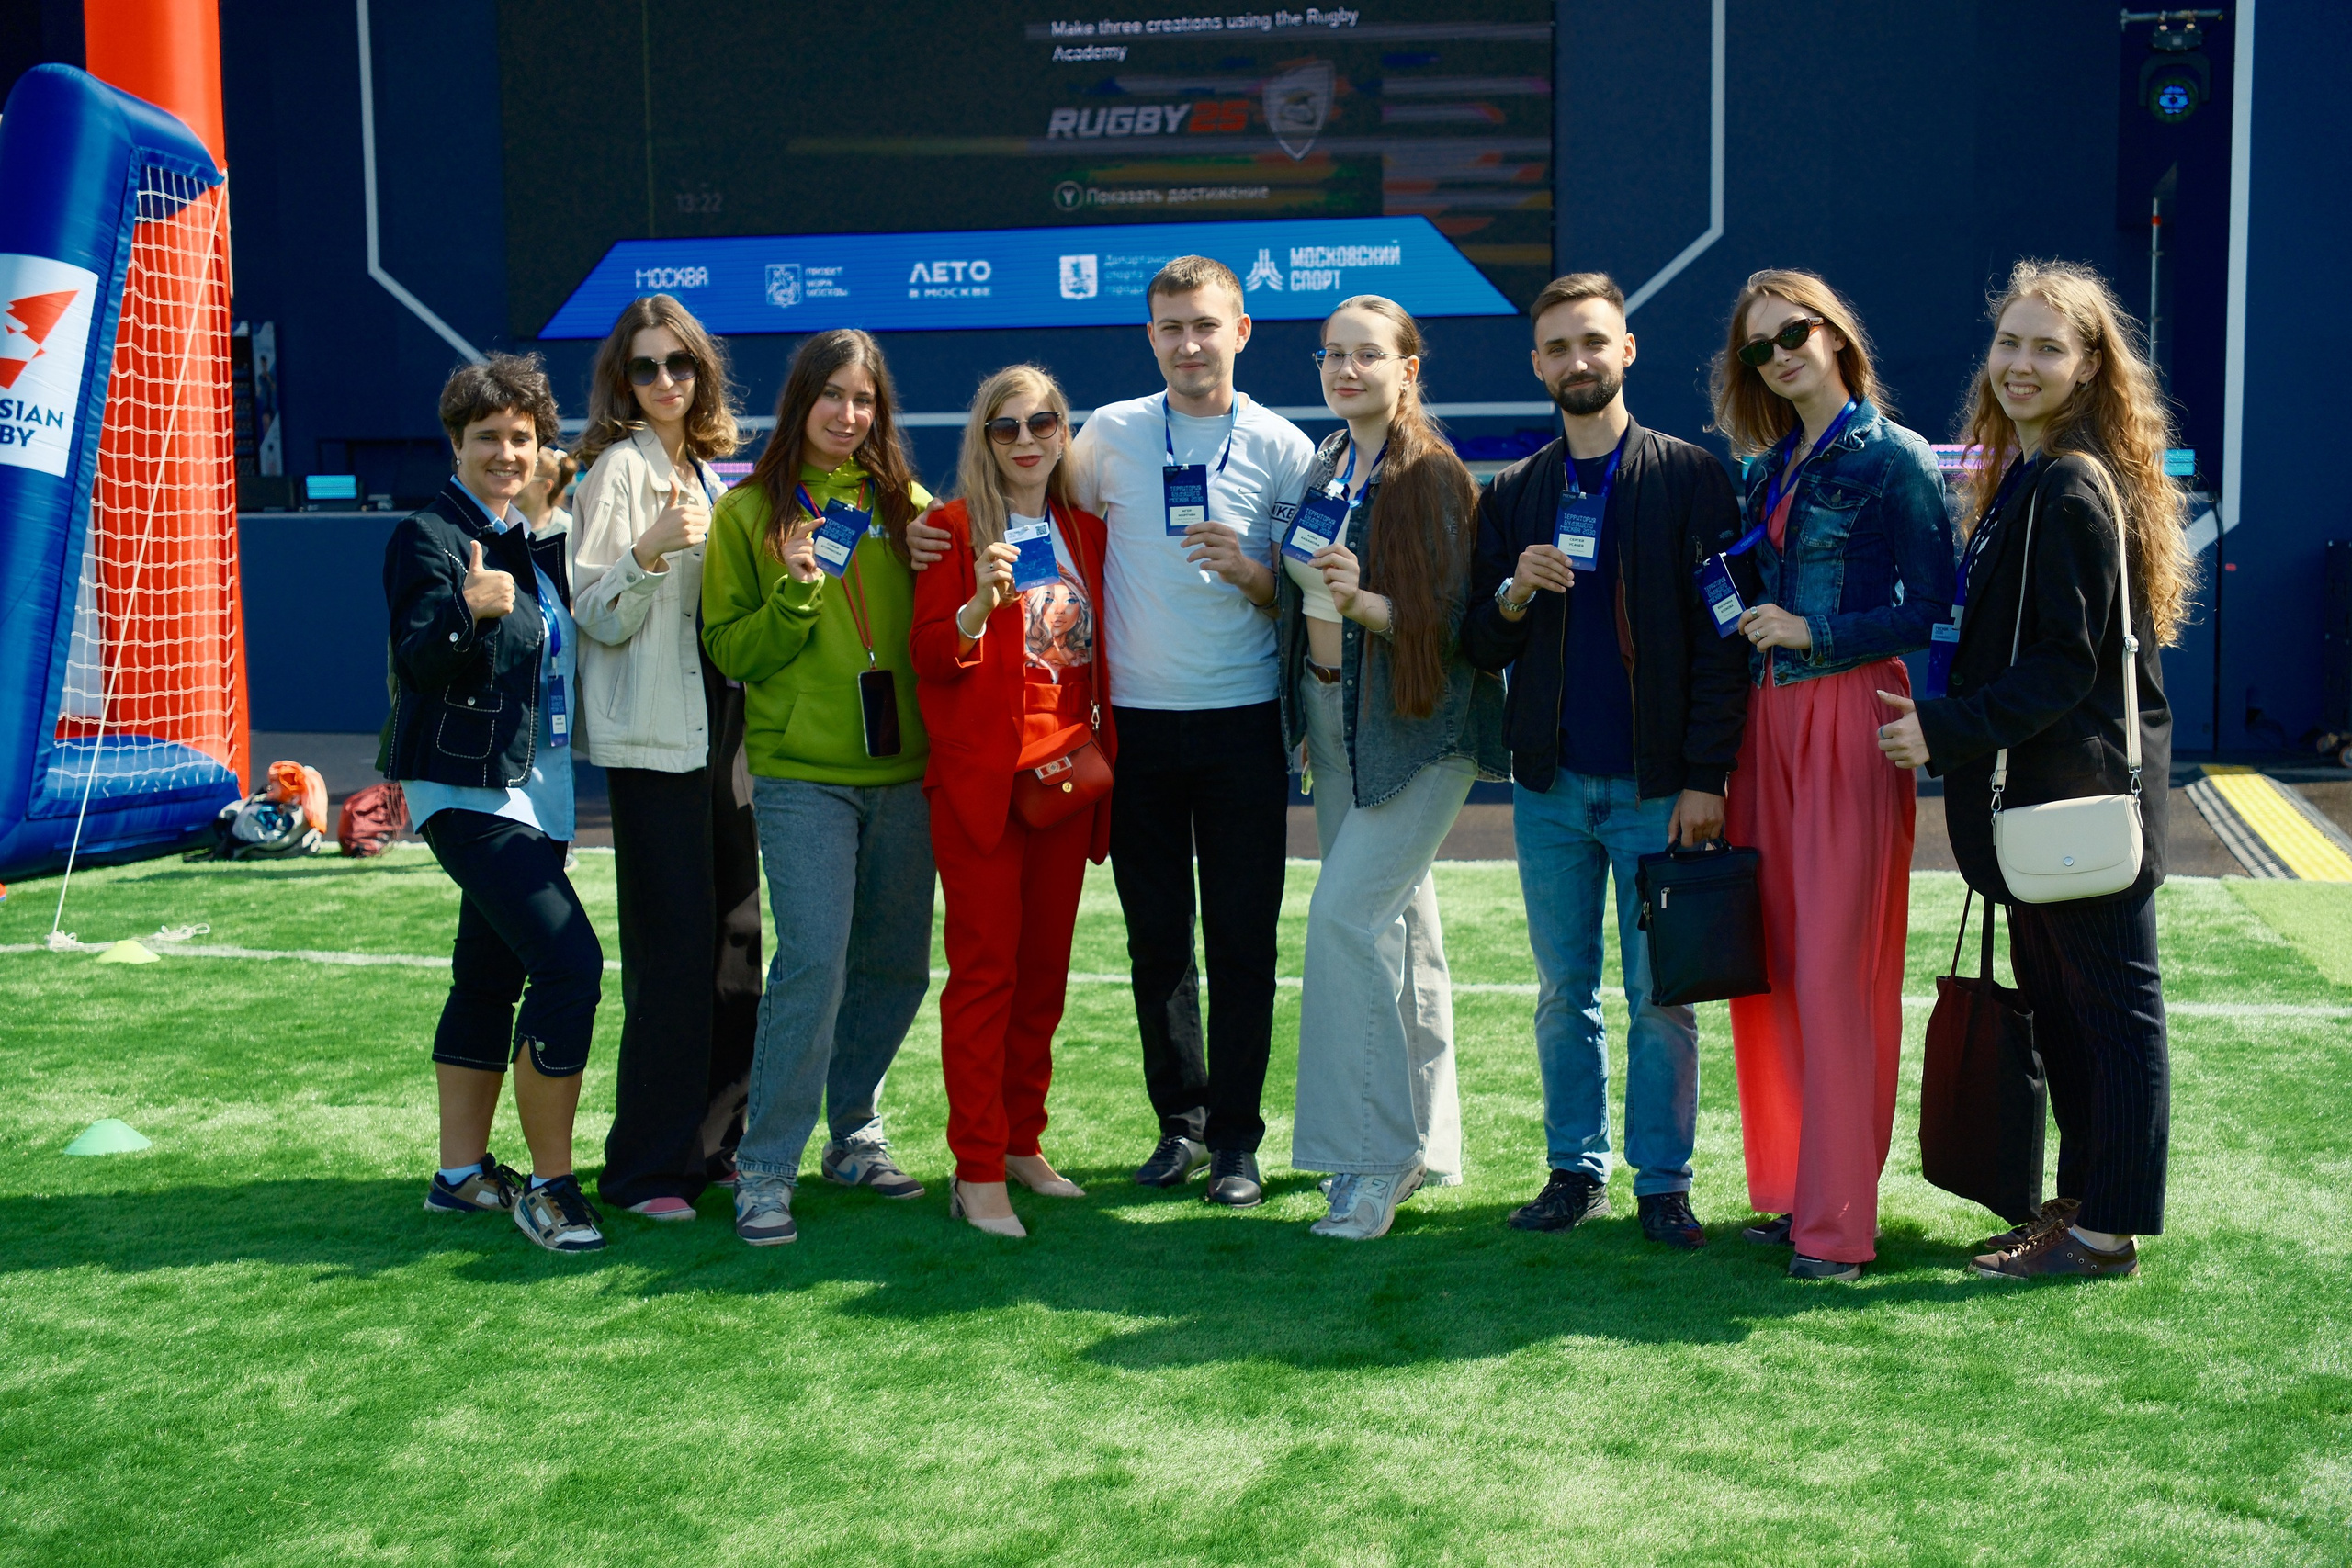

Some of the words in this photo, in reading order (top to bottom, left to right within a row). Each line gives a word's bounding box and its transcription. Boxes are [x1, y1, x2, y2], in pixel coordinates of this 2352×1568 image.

[1051, 19, 1095, 37] Make
[1098, 18, 1143, 36] three
[1146, 16, 1223, 34] creations
[1226, 12, 1272, 33] using
[1275, 10, 1304, 28] the
[1306, 7, 1359, 28] Rugby
[1052, 44, 1128, 62] Academy
[1046, 103, 1191, 139] RUGBY
[1189, 100, 1250, 132] 25
[1085, 188, 1163, 206] Показать
[1167, 186, 1270, 204] достижение
[1290, 239, 1401, 267] МОСКОВСКИЙ
[635, 266, 709, 288] МОСКВА
[909, 260, 991, 284] ЛЕТО
[1290, 270, 1341, 291] СПОРТ
[1564, 513, 1597, 524] ТЕРРИТОРИЯ
[1319, 526, 1333, 536] 2030
